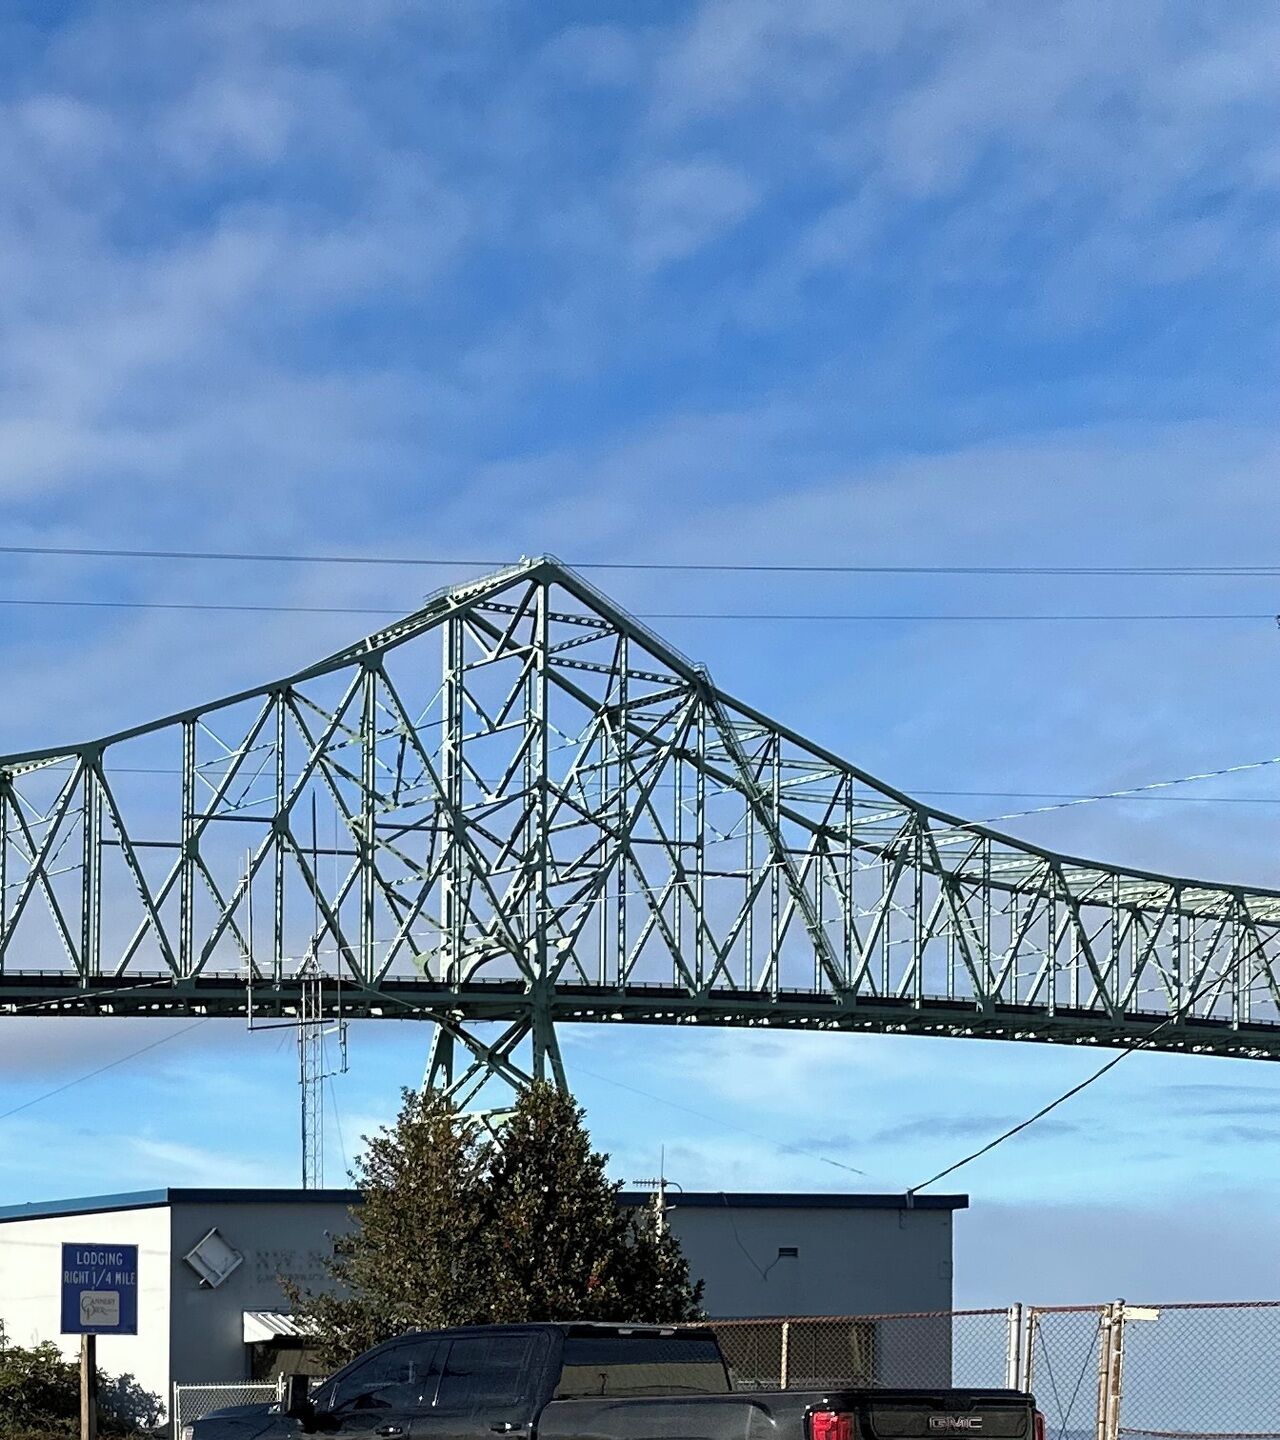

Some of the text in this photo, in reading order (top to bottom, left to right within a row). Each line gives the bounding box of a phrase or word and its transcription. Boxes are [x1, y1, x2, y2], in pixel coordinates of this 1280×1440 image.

[76, 1251, 123, 1266] LODGING
[64, 1269, 136, 1287] RIGHT 1/4 MILE
[929, 1416, 982, 1430] GMC
